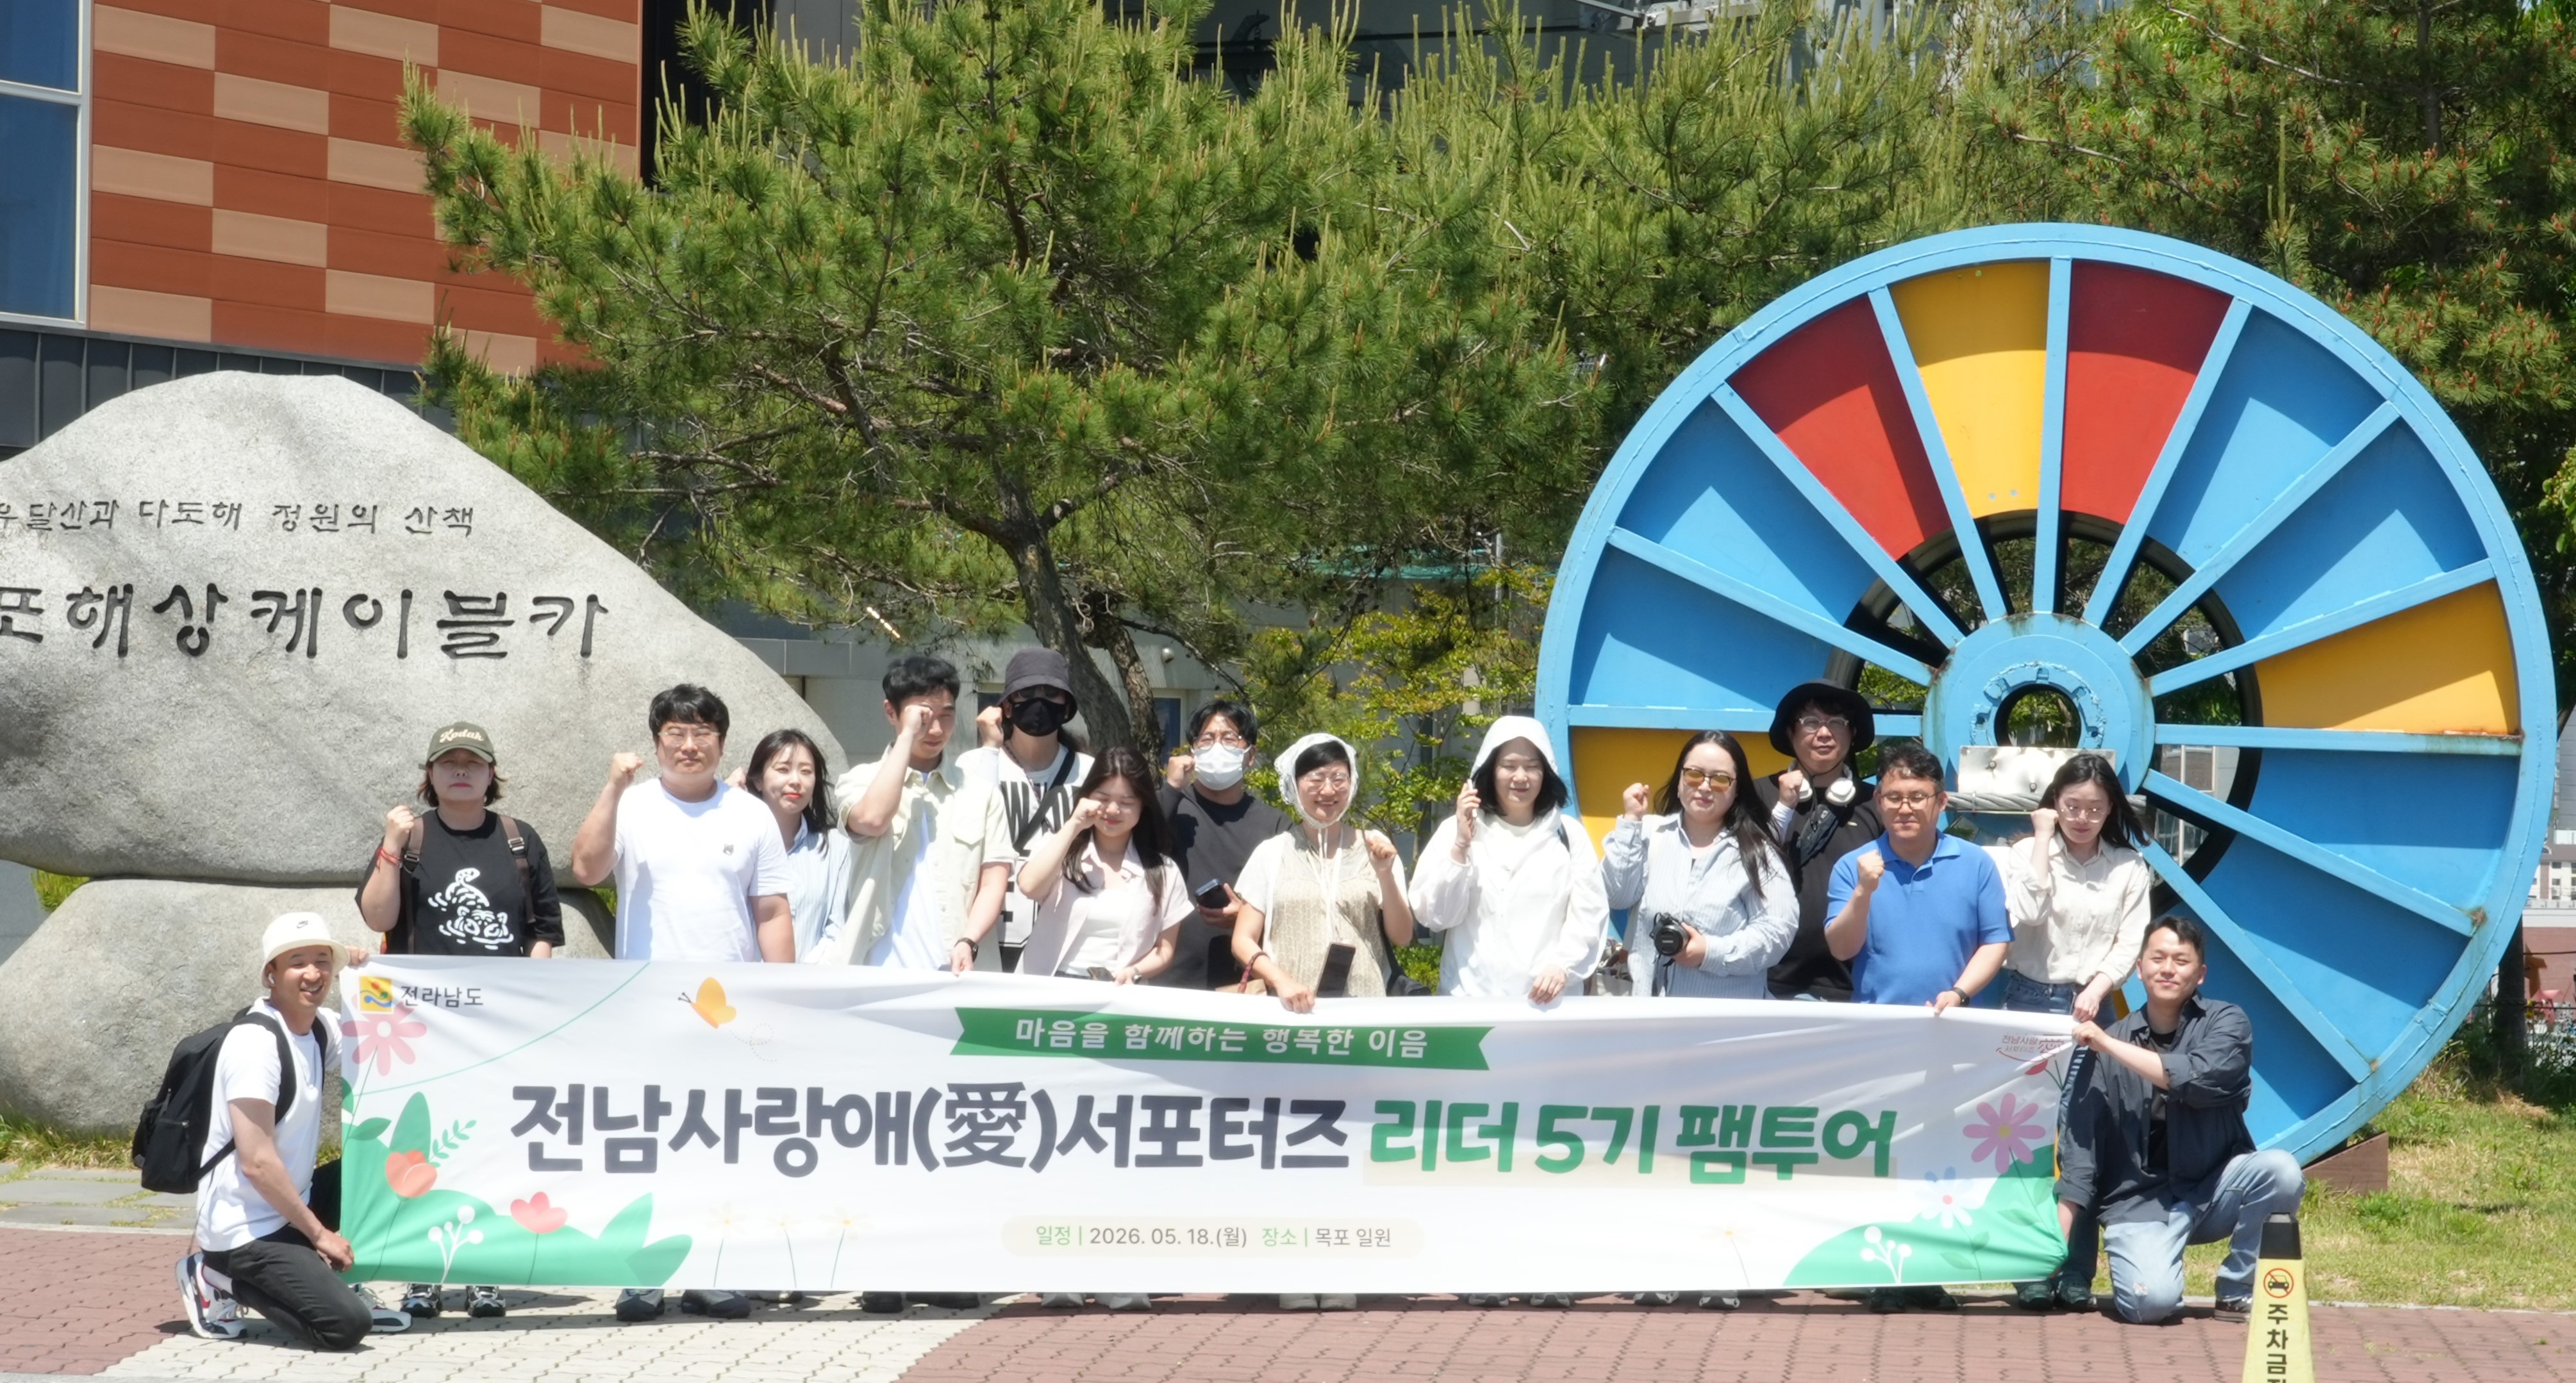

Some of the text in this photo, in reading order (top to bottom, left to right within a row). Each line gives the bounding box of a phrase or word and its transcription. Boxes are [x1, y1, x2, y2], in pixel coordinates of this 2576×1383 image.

[139, 502, 242, 531] 다도해
[272, 504, 378, 534] 정원의
[404, 506, 474, 537] 산책
[401, 985, 483, 1008] 전라남도
[1015, 1018, 1428, 1059] 마음을 함께하는 행복한 이음
[511, 1081, 1897, 1184] 전남사랑애(愛)서포터즈 리더 5기 팸투어
[1035, 1225, 1392, 1248] 일정 2026. 05. 18.(월) 장소 목포 일원
[2266, 1304, 2289, 1383] 주차금
